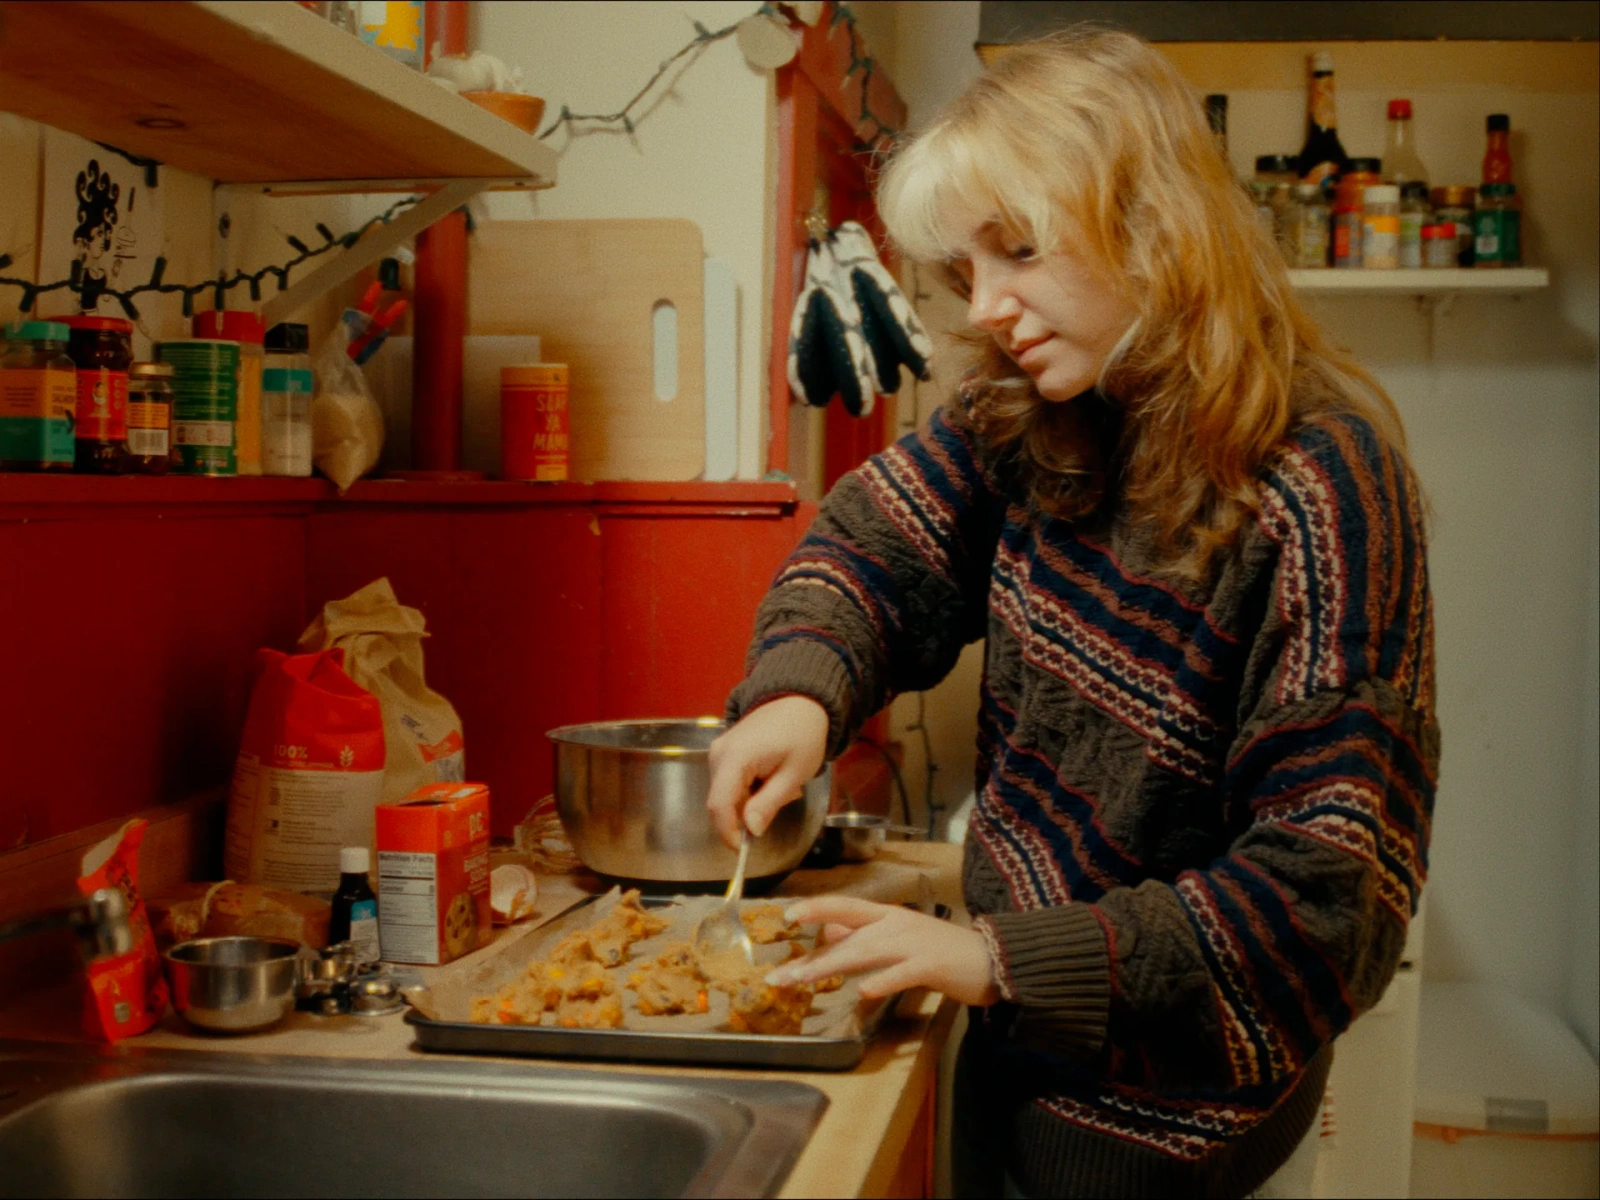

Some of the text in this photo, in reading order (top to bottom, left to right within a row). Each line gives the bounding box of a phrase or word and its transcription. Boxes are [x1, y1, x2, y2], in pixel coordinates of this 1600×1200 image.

[274, 744, 309, 759] 100%
[379, 853, 434, 864] Nutrition Facts
